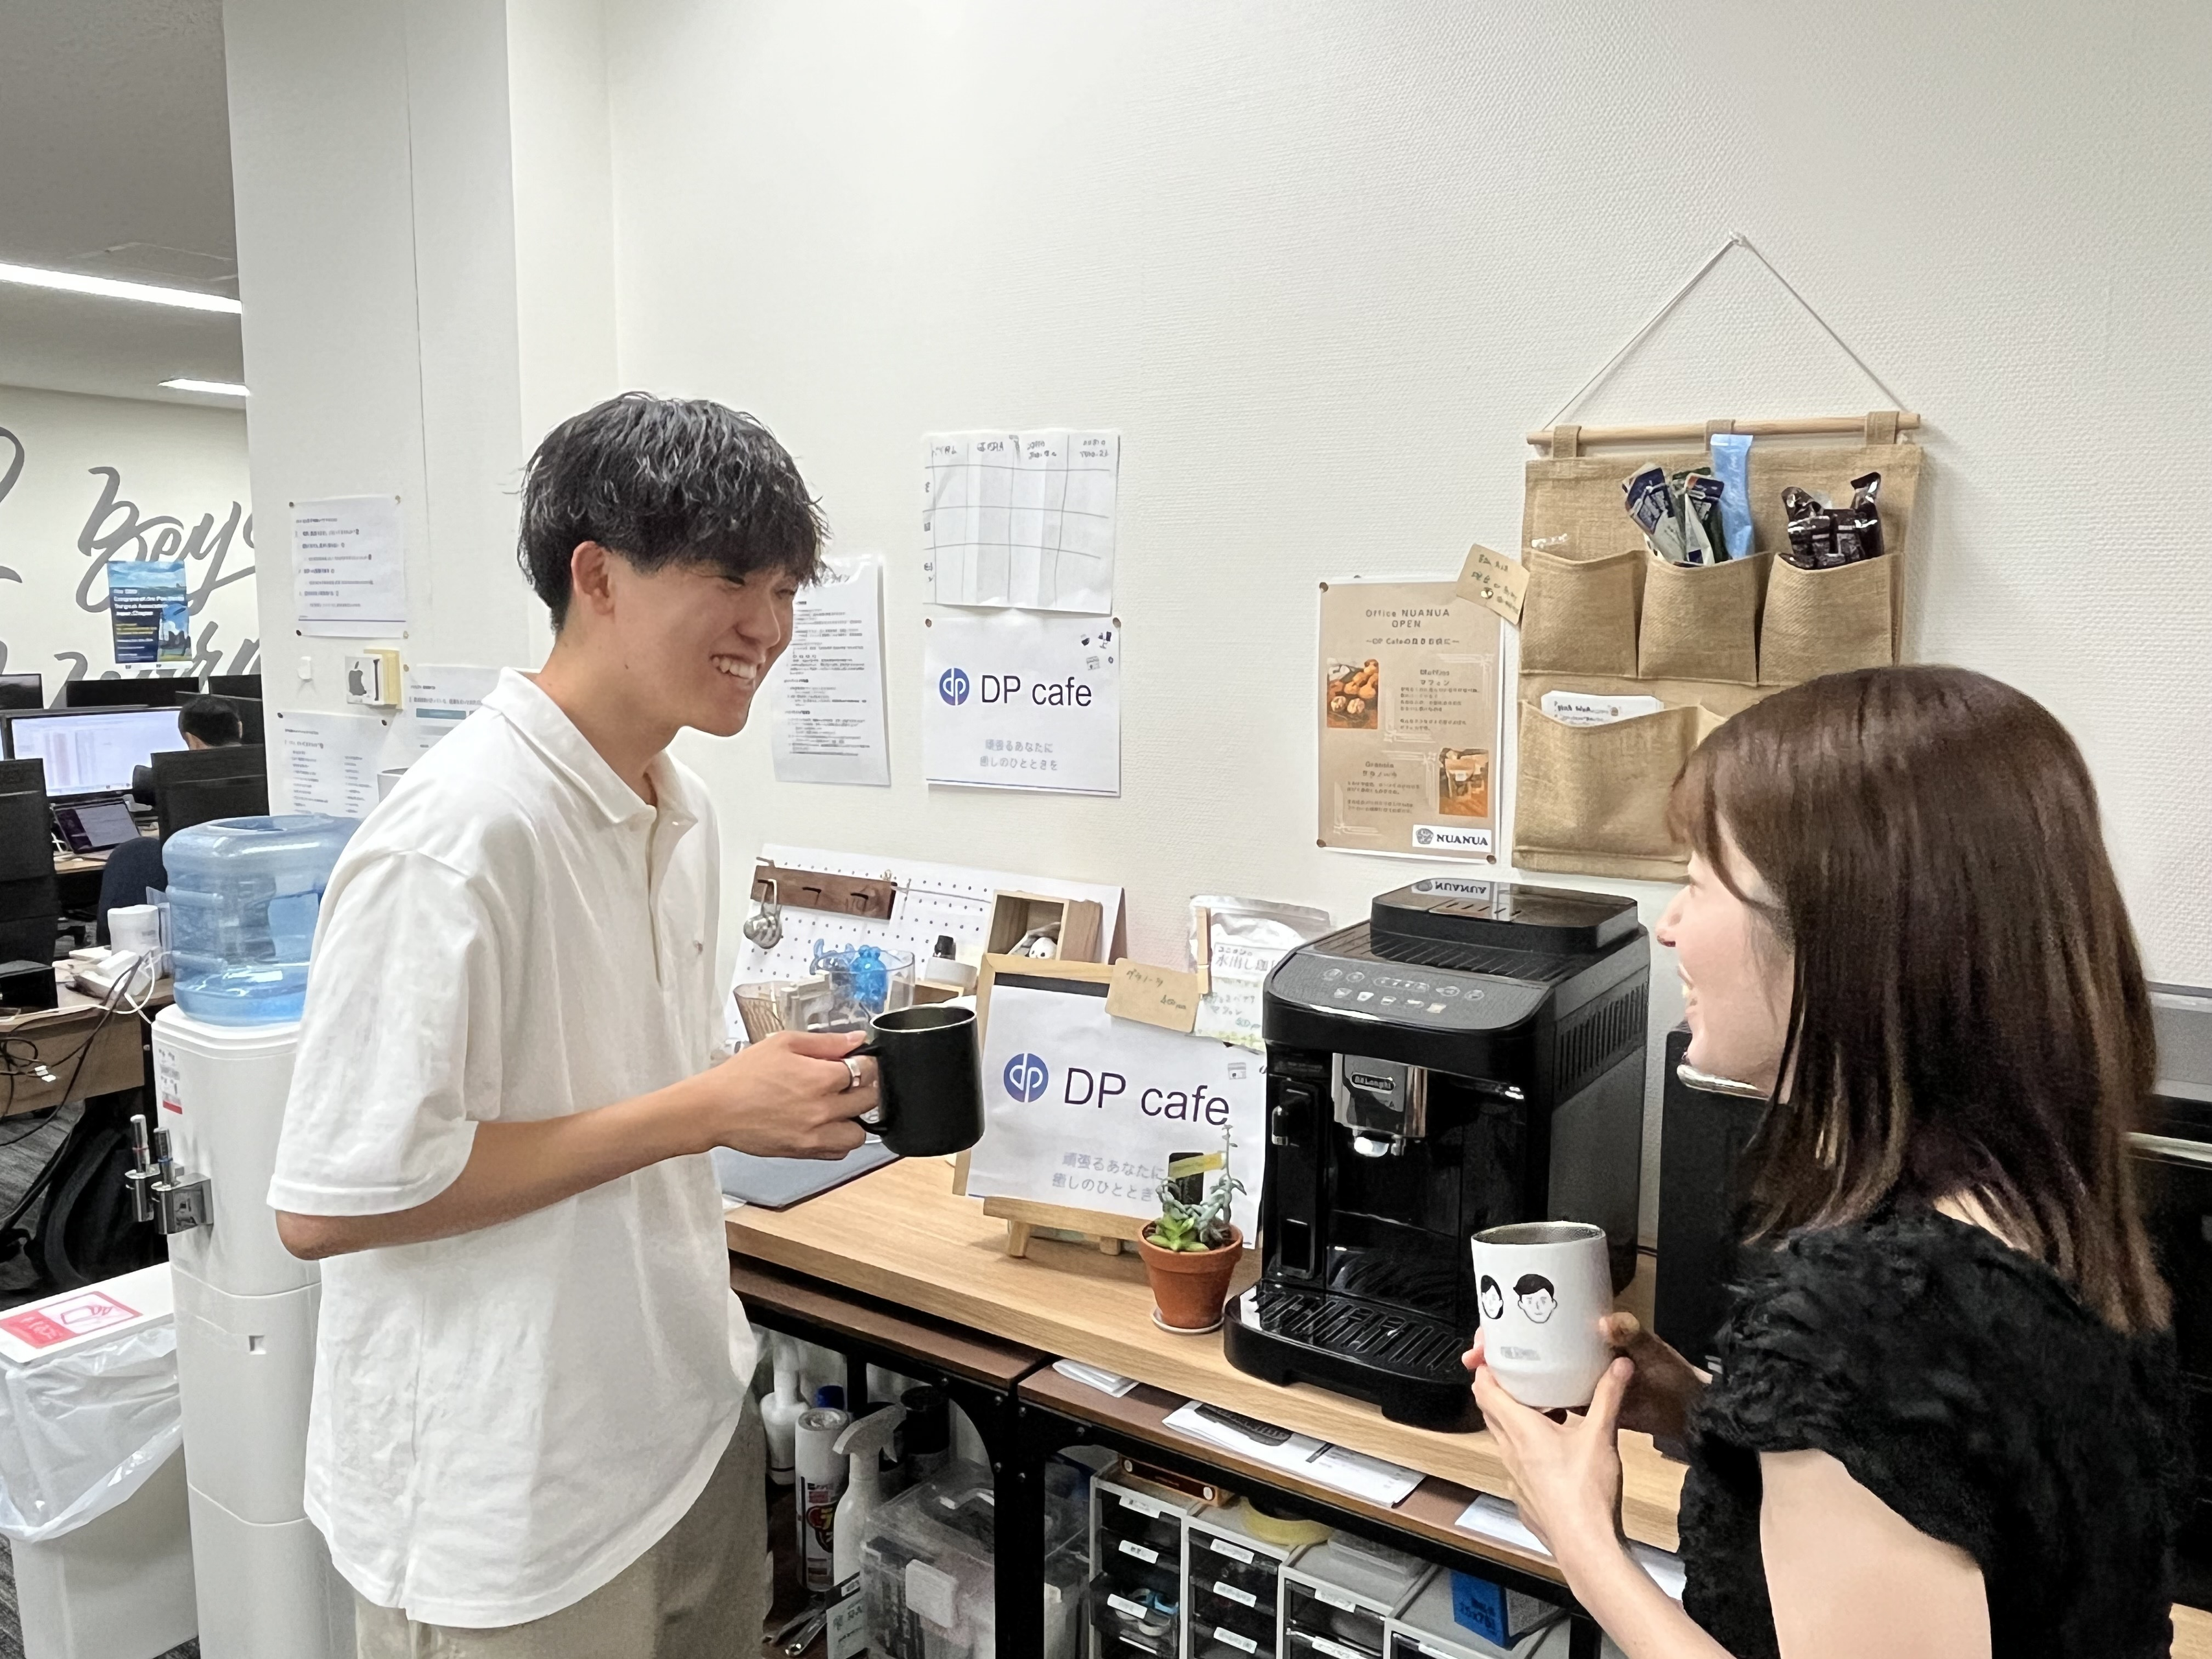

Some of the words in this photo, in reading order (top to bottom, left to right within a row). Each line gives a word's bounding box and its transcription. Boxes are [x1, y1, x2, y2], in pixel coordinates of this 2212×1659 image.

[1366, 609, 1396, 618] Office
[1401, 609, 1450, 617] NUANUA
[1391, 620, 1421, 628] OPEN
[981, 675, 1021, 703] DP
[1032, 676, 1092, 707] cafe
[1436, 833, 1489, 846] NUANUA
[1064, 1067, 1126, 1108] DP
[1141, 1085, 1229, 1126] cafe
